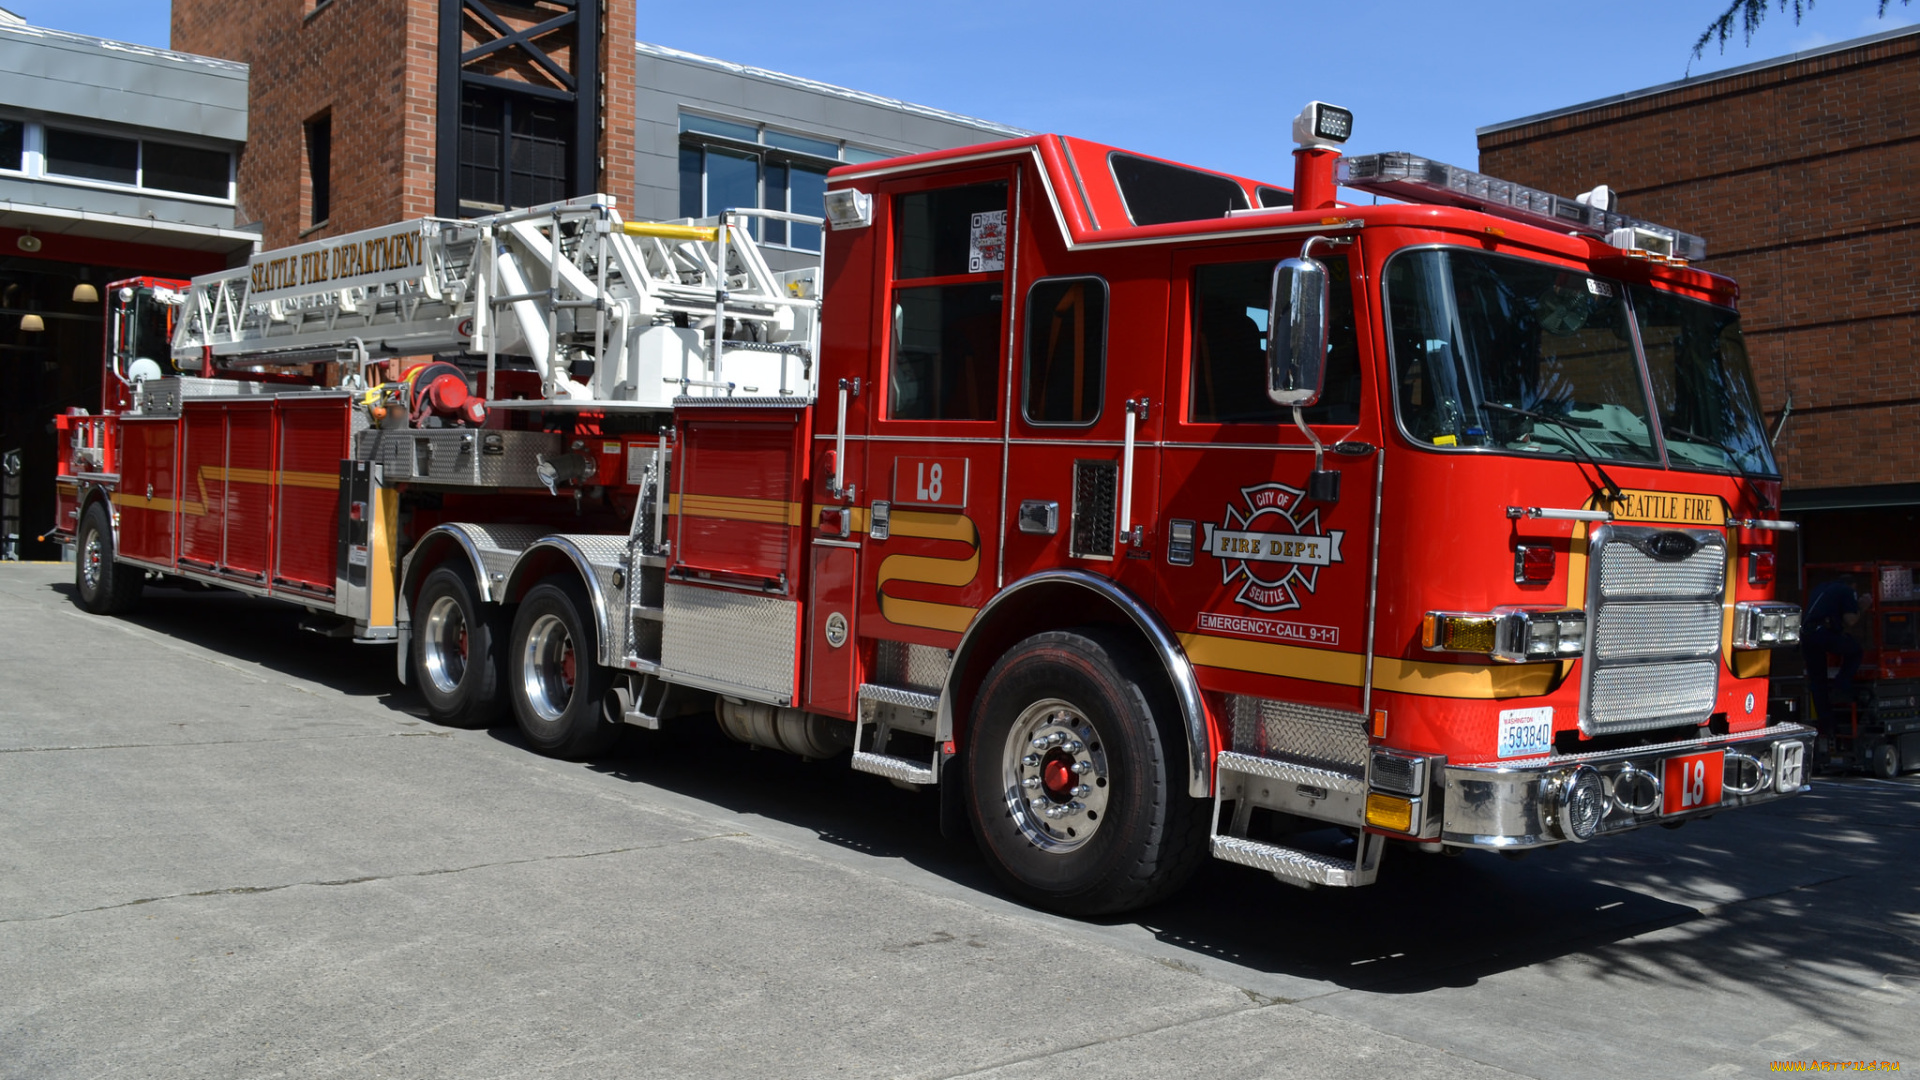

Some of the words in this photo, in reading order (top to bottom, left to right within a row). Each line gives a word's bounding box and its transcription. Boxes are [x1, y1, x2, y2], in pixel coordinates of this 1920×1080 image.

[251, 255, 297, 294] SEATTLE
[300, 248, 330, 286] FIRE
[331, 230, 424, 280] DEPARTMENT
[916, 462, 943, 502] L8
[1256, 491, 1275, 507] CITY
[1277, 492, 1290, 508] OF
[1616, 493, 1679, 519] SEATTLE
[1683, 497, 1713, 521] FIRE
[1221, 536, 1261, 554] FIRE
[1270, 540, 1322, 560] DEPT.
[1250, 585, 1285, 604] SEATTLE
[1309, 627, 1336, 642] 9-1-1
[1681, 759, 1705, 807] L8
